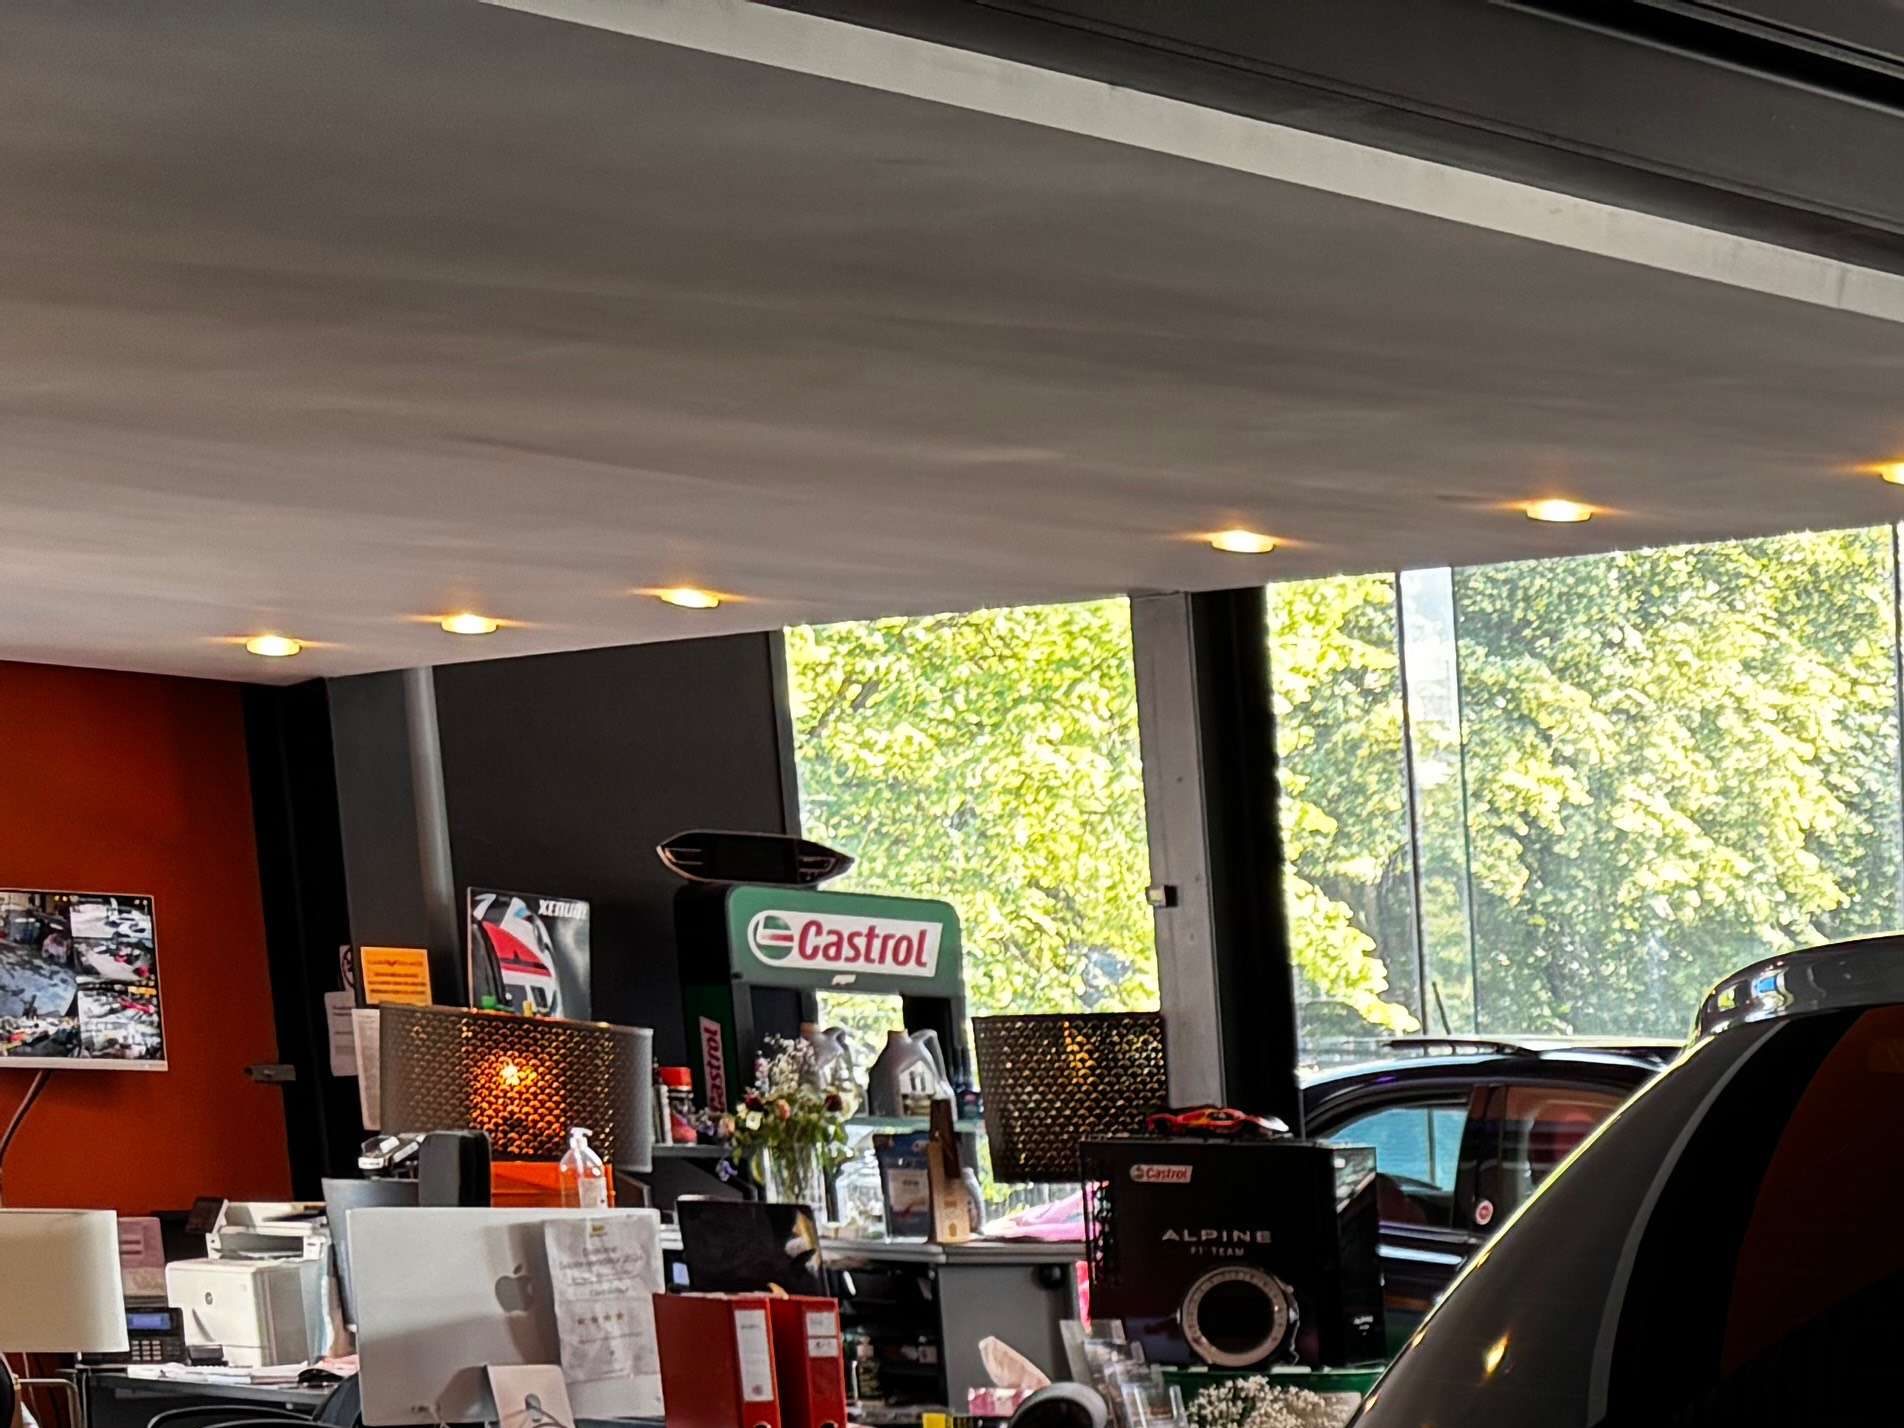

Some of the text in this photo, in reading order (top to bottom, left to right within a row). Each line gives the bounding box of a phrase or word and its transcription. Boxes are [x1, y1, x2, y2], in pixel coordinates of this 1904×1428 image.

[798, 919, 928, 968] Castrol
[1145, 1167, 1189, 1181] Castrol
[1161, 1229, 1273, 1244] ALPINE
[1211, 1246, 1246, 1257] TEAM
